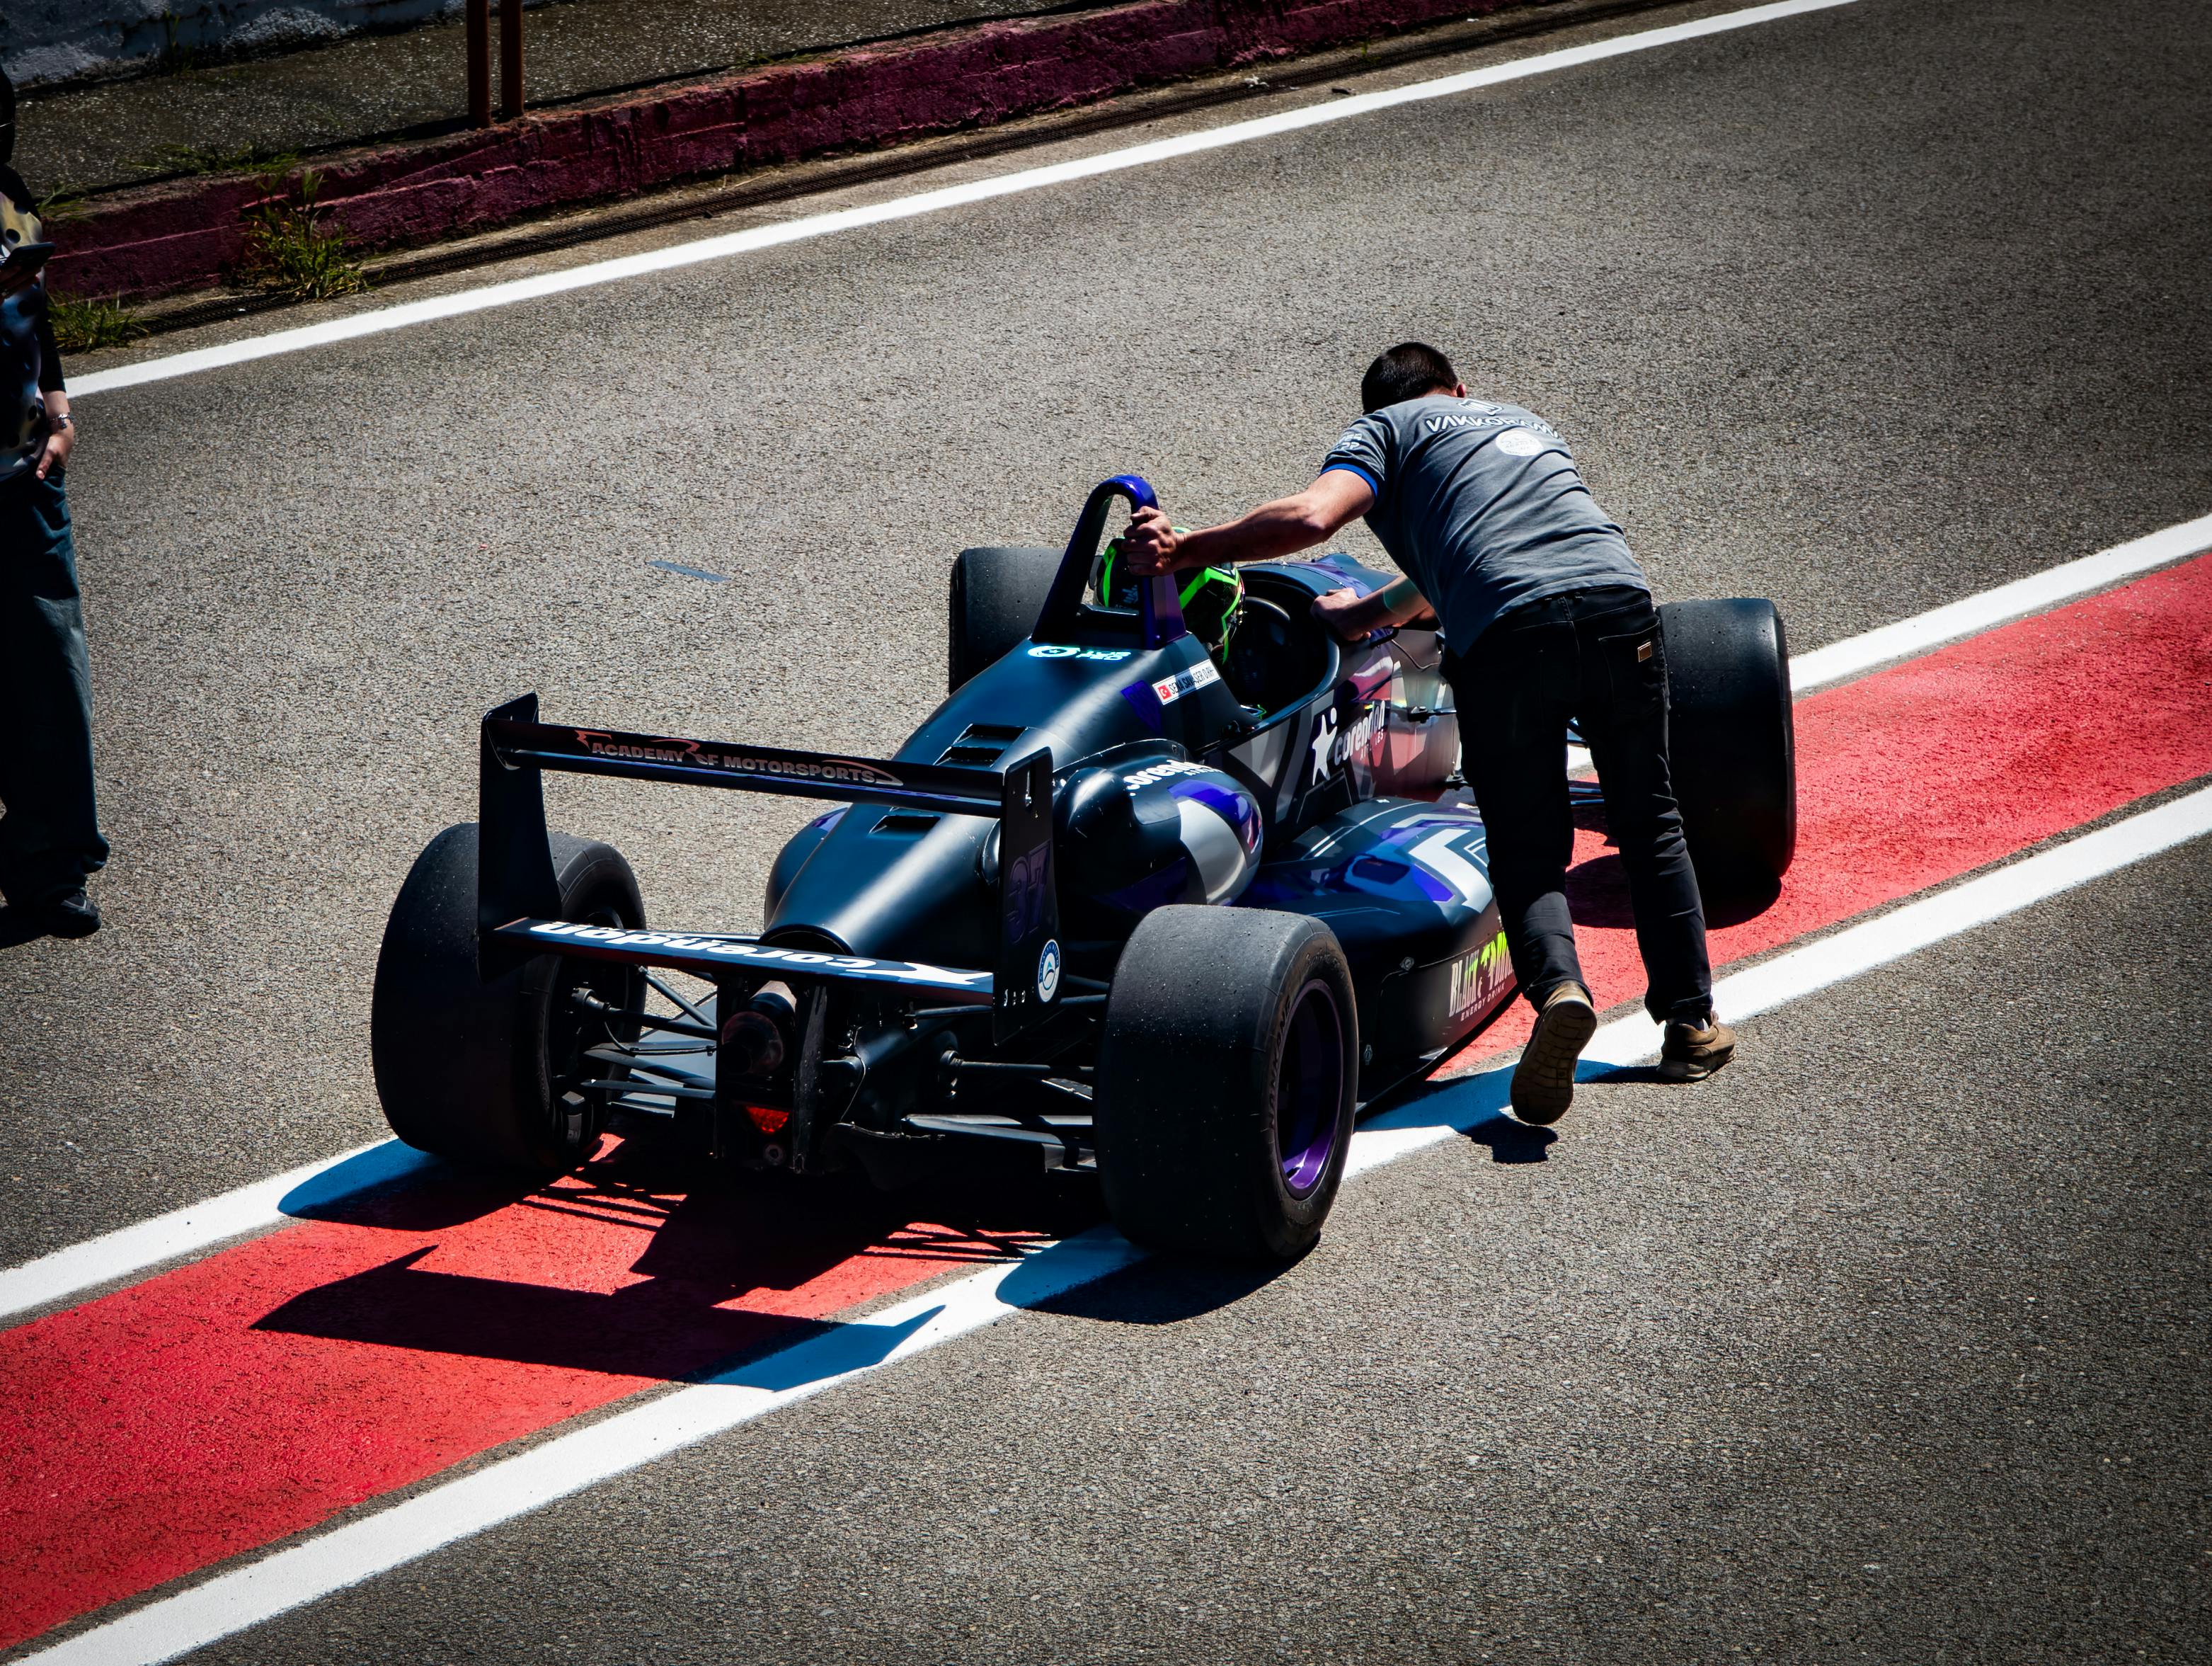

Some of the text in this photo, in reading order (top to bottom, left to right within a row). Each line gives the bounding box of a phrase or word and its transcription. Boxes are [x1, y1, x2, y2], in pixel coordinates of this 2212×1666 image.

[1334, 700, 1386, 766] corendon
[592, 743, 686, 762] ACADEMY
[723, 755, 876, 783] MOTORSPORTS
[529, 922, 878, 968] corendon
[1449, 949, 1480, 1017] BLACK
[1460, 981, 1506, 1022] ENERGY DRINK
